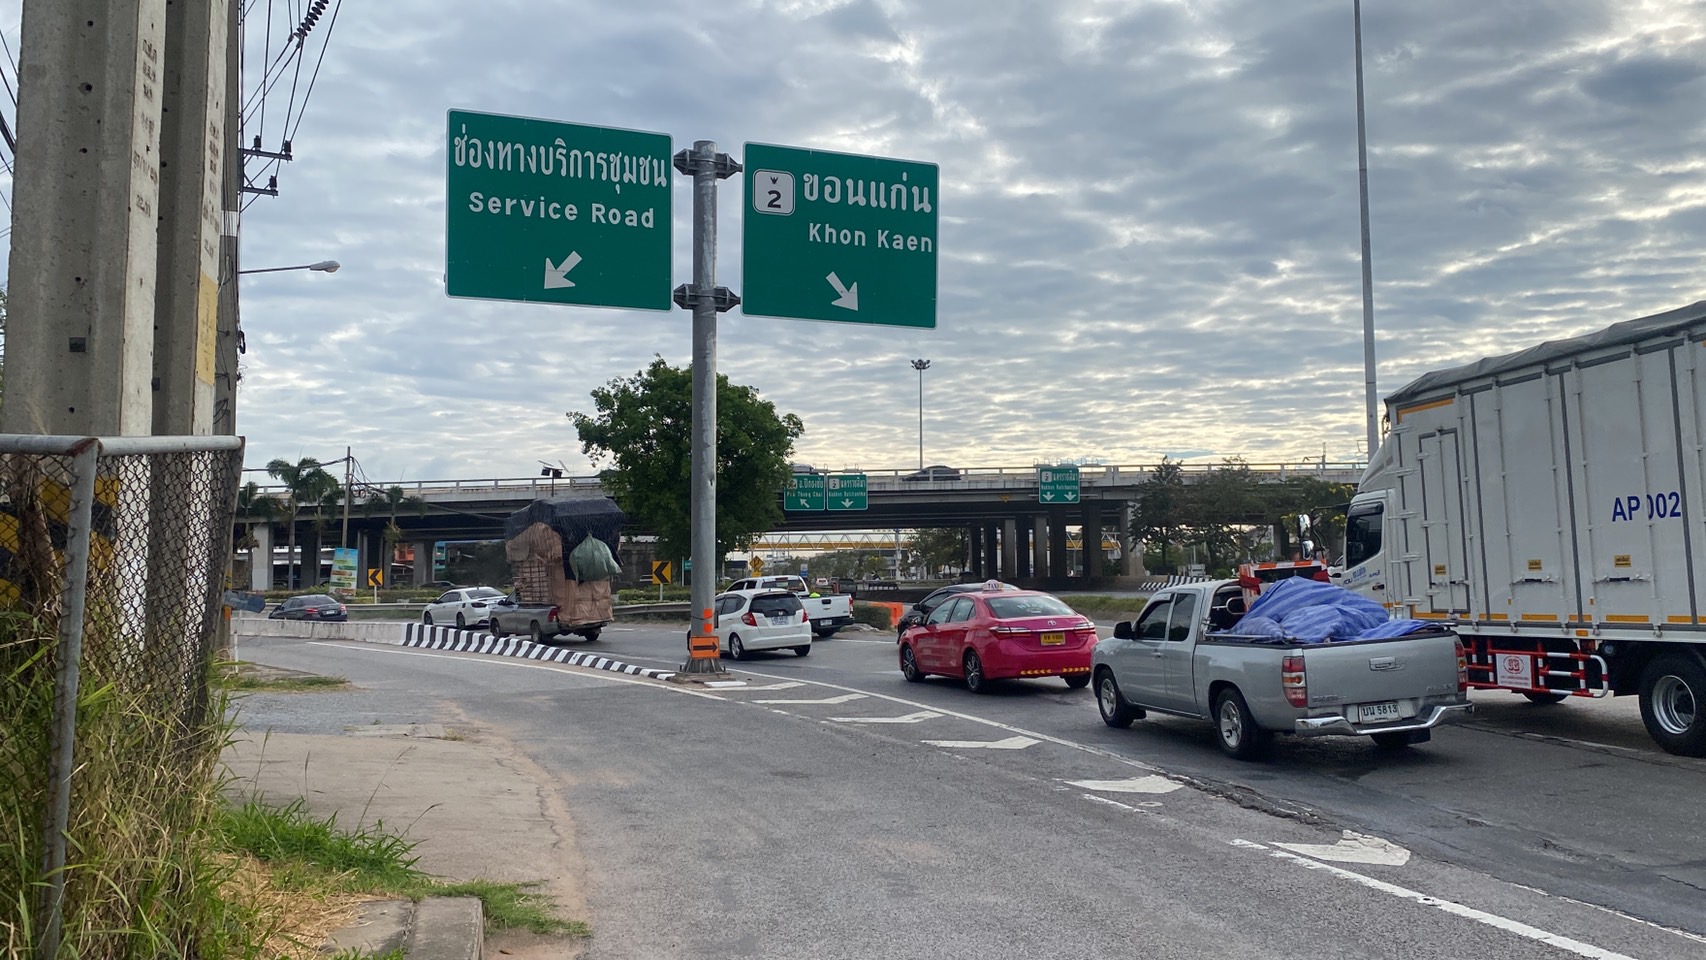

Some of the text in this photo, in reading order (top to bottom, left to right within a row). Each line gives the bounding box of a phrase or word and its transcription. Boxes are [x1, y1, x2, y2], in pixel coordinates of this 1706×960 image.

[454, 123, 667, 195] ช่องทางบริการชุมชน
[768, 190, 781, 208] 2
[803, 172, 932, 213] ขอนแก่น
[468, 191, 655, 229] Service Road
[809, 222, 933, 253] Khon Kaen
[1377, 703, 1398, 715] 5813
